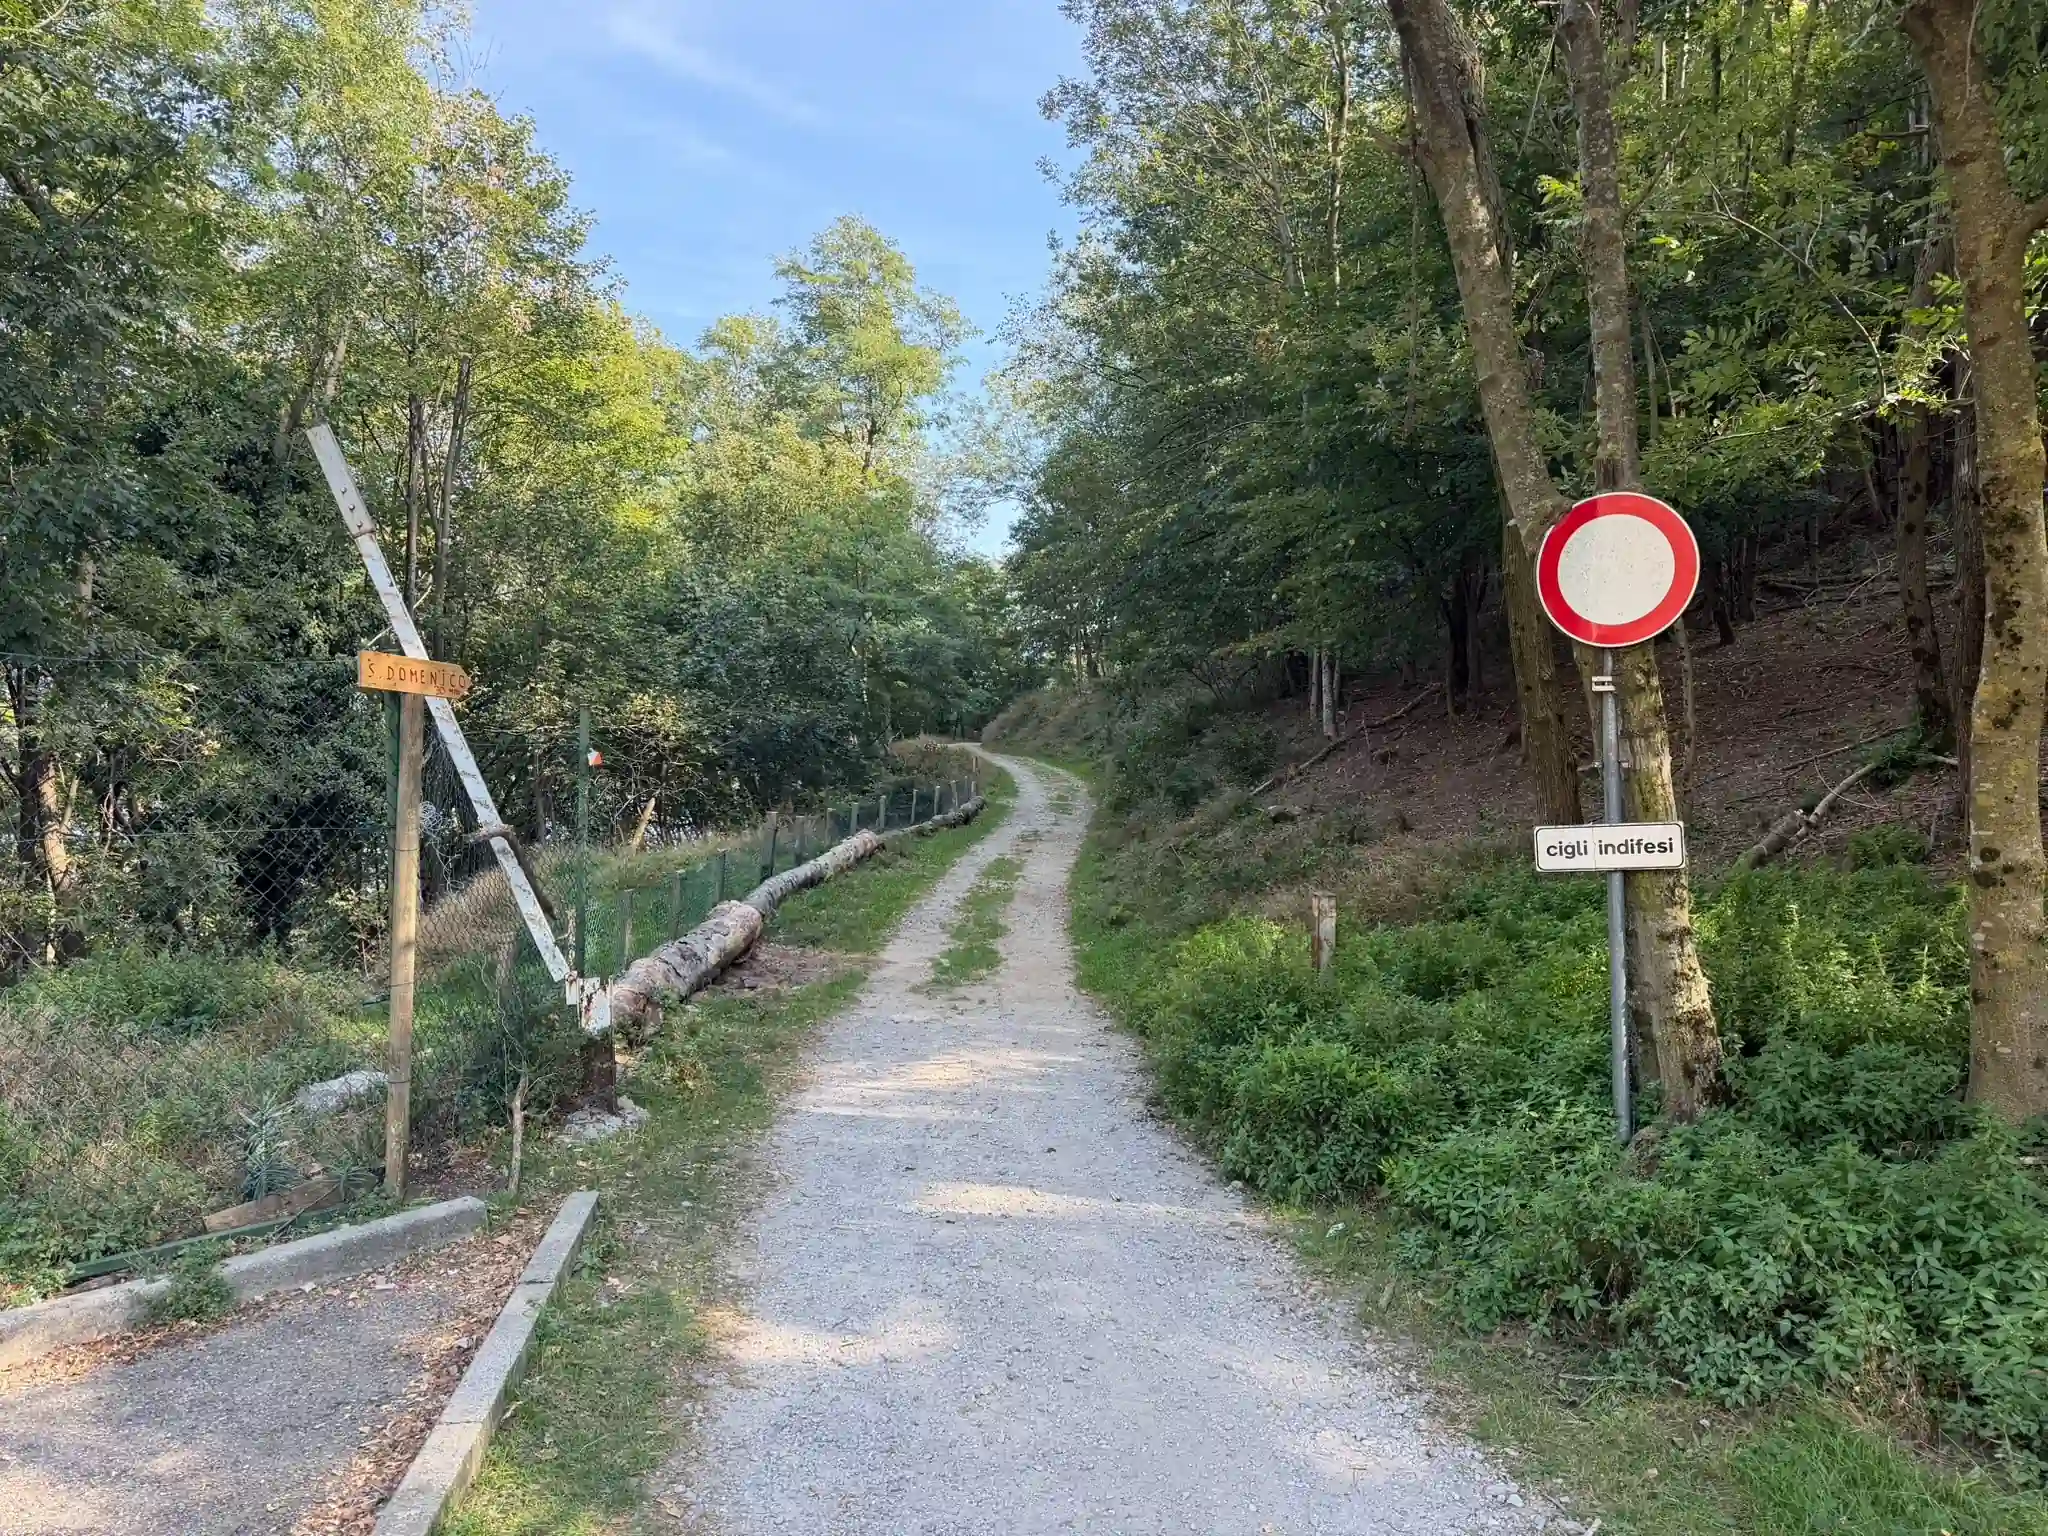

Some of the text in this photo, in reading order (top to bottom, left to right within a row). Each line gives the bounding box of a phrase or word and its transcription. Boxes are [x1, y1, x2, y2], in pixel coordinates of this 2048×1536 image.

[386, 665, 467, 689] DOMENICO
[1546, 837, 1674, 860] cigli indifesi
